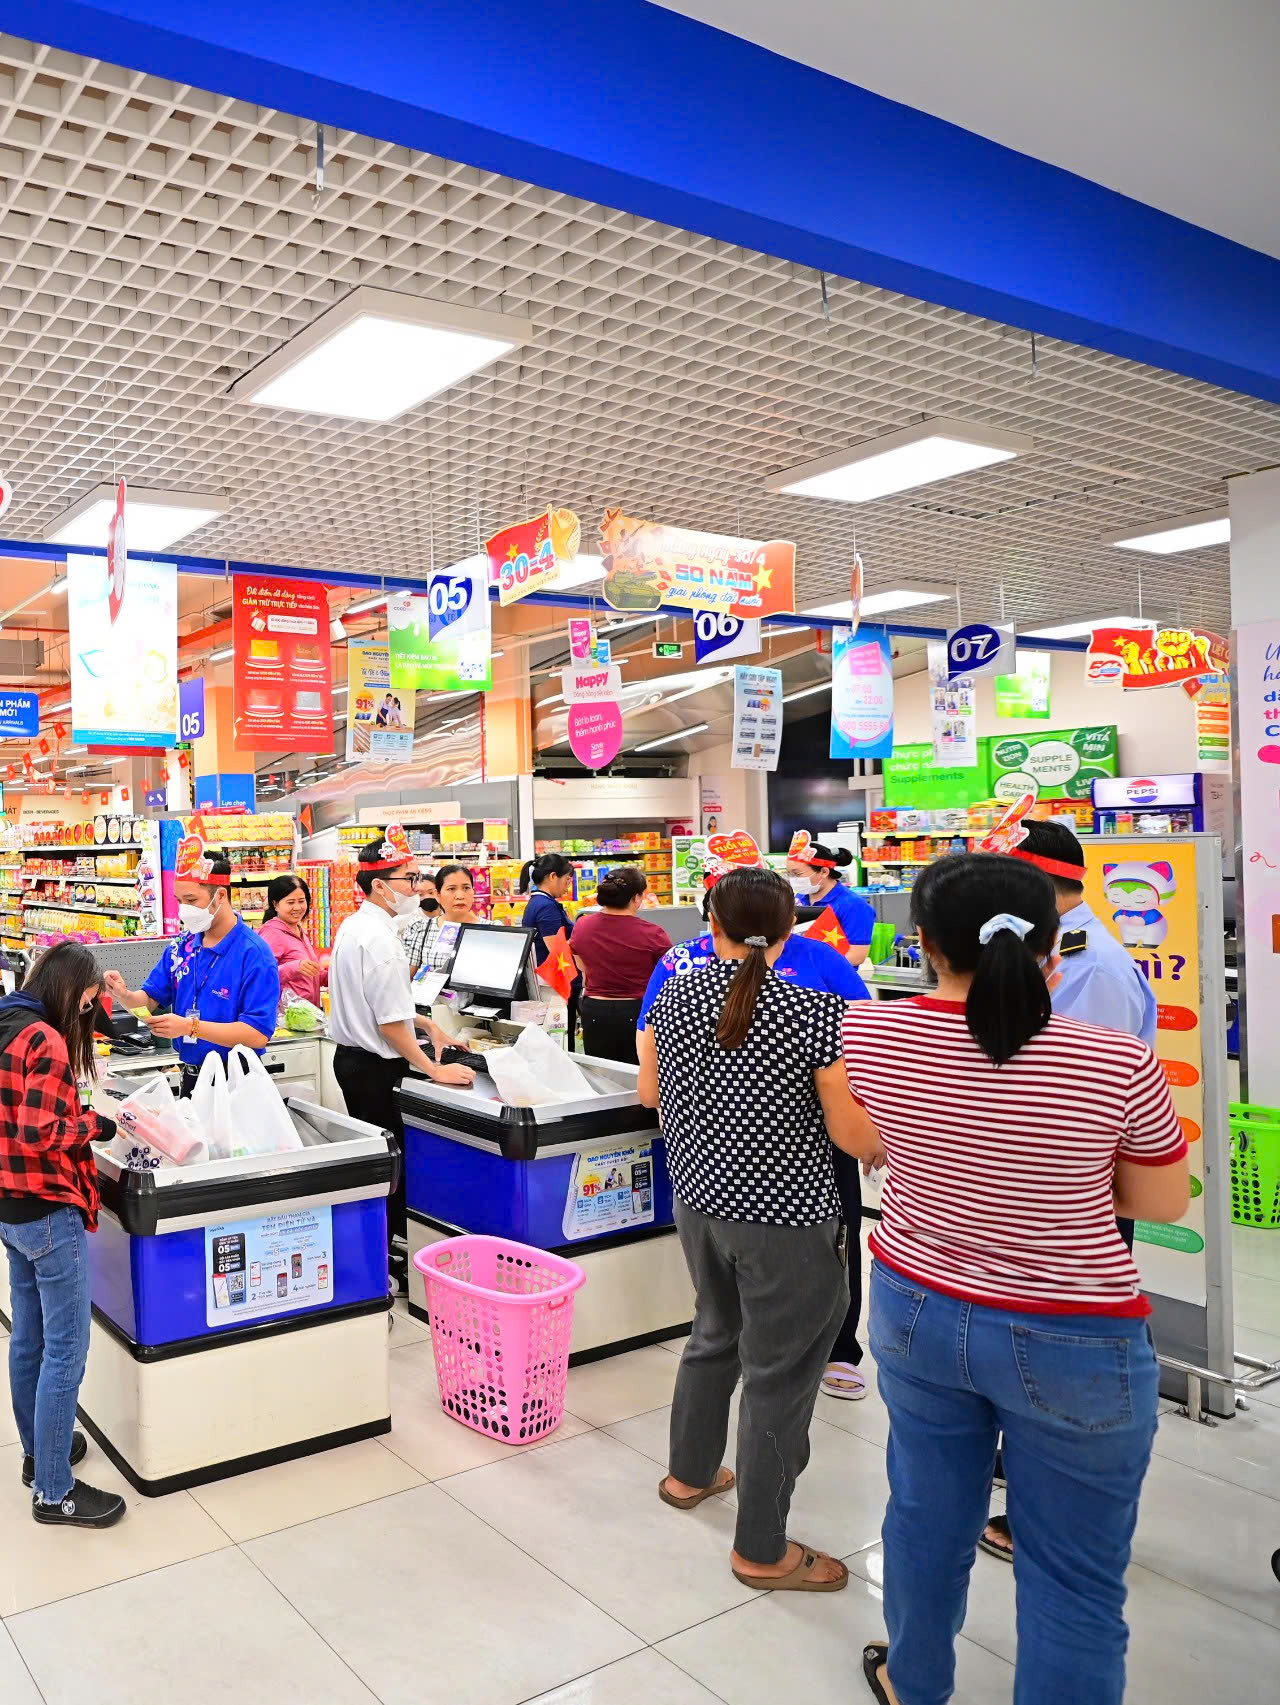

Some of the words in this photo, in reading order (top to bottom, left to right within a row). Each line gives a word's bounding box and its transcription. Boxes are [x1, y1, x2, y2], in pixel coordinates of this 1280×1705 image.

[734, 549, 766, 564] 30/4
[675, 563, 704, 583] 50
[430, 576, 468, 616] 05
[242, 598, 258, 606] GIẢM
[271, 600, 286, 608] TRỰC
[286, 601, 298, 609] TIẾP
[696, 613, 738, 642] 06
[951, 634, 993, 662] 07
[575, 671, 609, 689] Happy
[5, 697, 30, 708] PHẨM
[0, 706, 18, 717] MỚI
[182, 712, 200, 736] 05
[1082, 743, 1106, 752] MIN
[1030, 753, 1073, 764] SUPPLE
[1032, 764, 1071, 773] MENTS
[890, 771, 965, 785] Supplements
[1000, 782, 1034, 792] HEALTH
[1126, 787, 1160, 796] PEPSI
[600, 1151, 621, 1161] NGUYÊN
[583, 1183, 601, 1197] 91%
[261, 1223, 276, 1231] TEM
[217, 1244, 230, 1254] 05
[218, 1262, 231, 1273] 05
[283, 1258, 287, 1266] 1
[292, 1284, 298, 1292] 4
